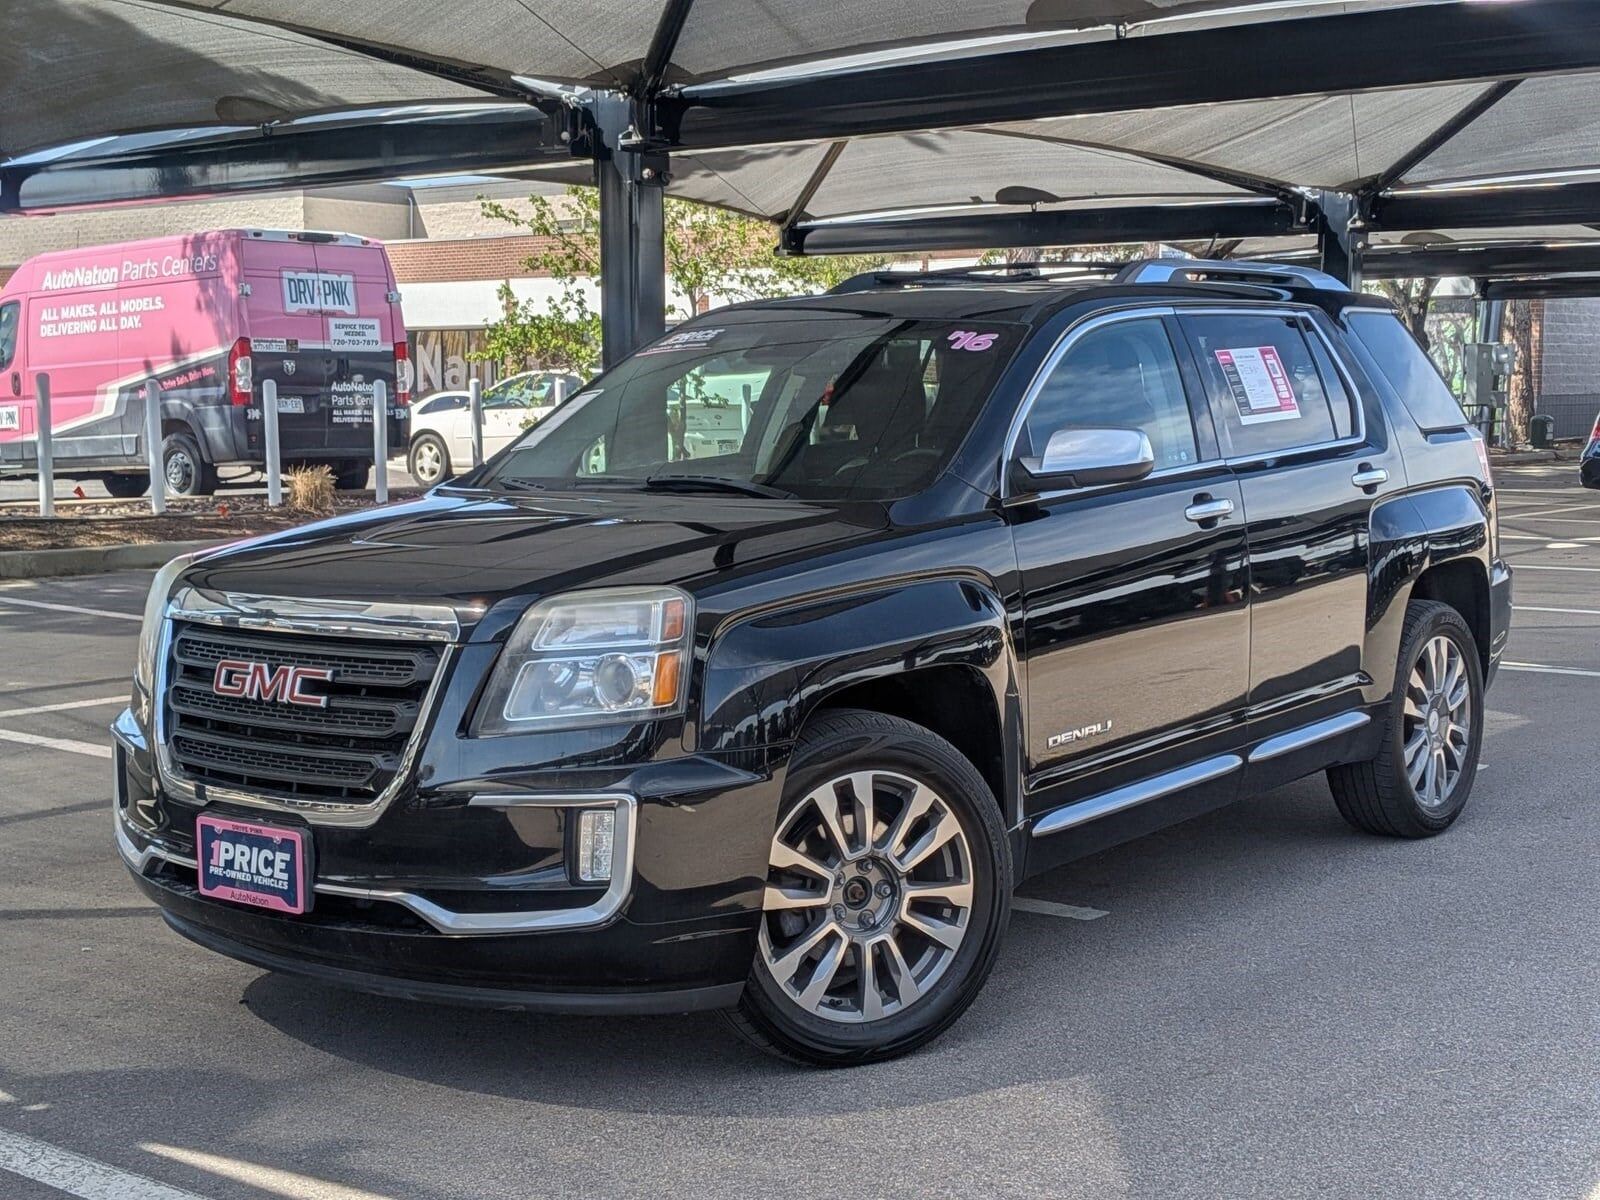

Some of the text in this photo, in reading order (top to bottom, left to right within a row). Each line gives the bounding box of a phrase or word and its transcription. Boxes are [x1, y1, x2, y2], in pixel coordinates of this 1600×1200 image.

[42, 255, 217, 291] AutoNation Parts Centers
[287, 277, 351, 306] DRV PNK
[41, 309, 59, 321] ALL
[100, 302, 118, 315] ALL
[120, 297, 164, 312] MODELS.
[40, 315, 141, 337] DELIVERING ALL DAY.
[331, 381, 374, 392] AutoNatio
[331, 395, 353, 406] Parts
[213, 659, 333, 708] GMC
[1046, 719, 1113, 749] DENALI
[209, 866, 289, 890] PRE-OWNED VEHICLES
[229, 891, 270, 906] AutoNation
